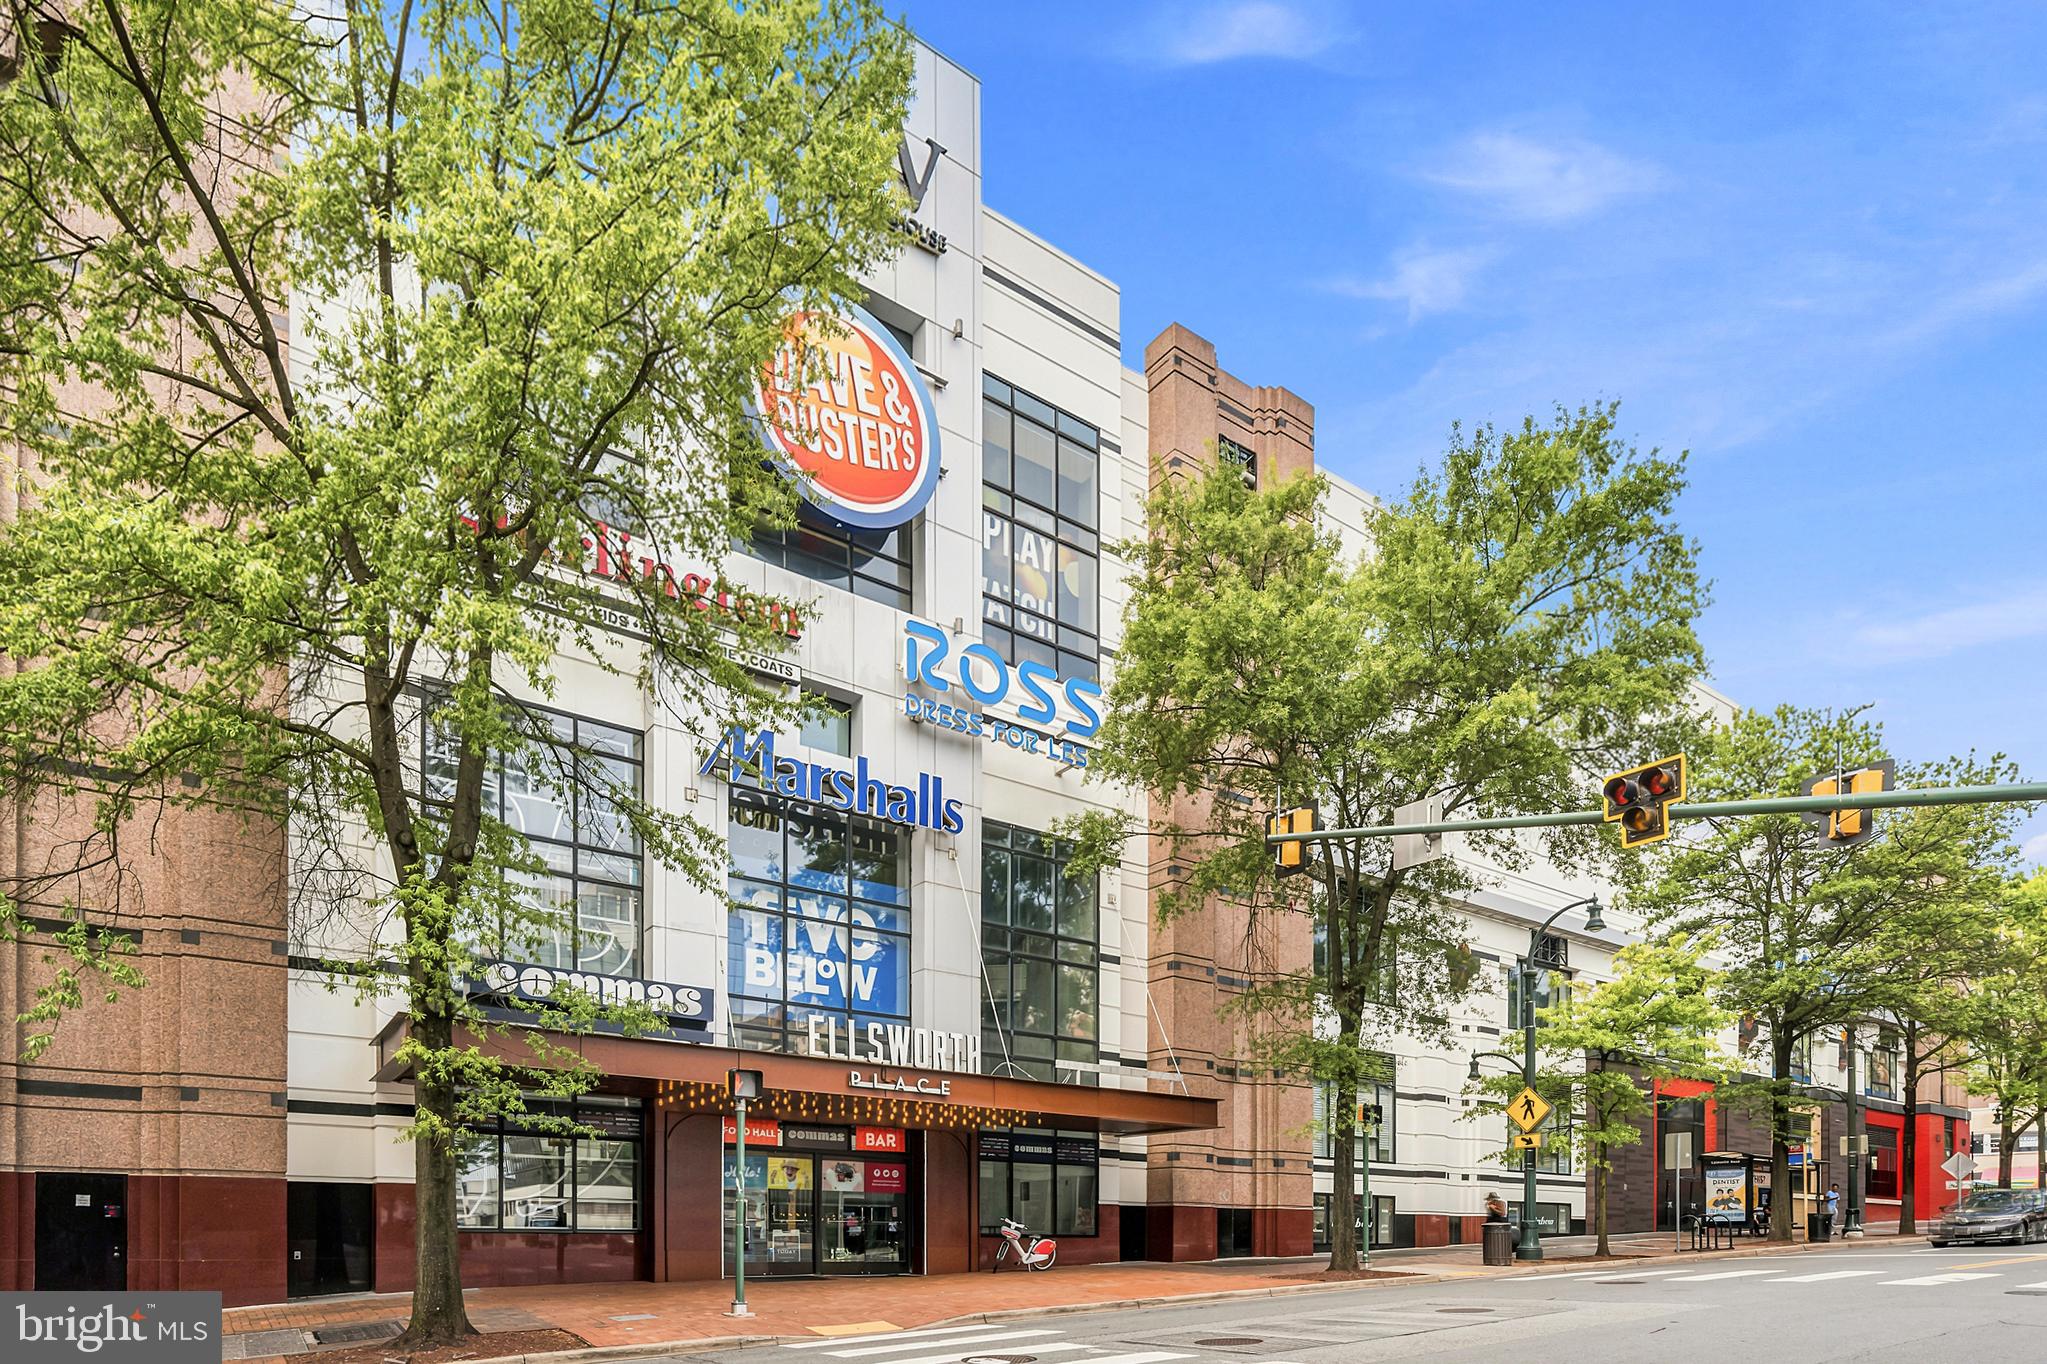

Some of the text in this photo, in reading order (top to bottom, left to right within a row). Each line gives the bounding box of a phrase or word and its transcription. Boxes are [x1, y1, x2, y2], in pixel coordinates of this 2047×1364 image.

[880, 370, 912, 427] &
[776, 394, 916, 472] BUSTER'S
[983, 512, 1055, 573] PLAY
[750, 654, 794, 677] COATS
[903, 619, 1103, 738] ROSS
[904, 693, 1090, 768] DRESS FOR LES
[698, 724, 964, 836] Marshalls
[750, 890, 878, 961] five
[485, 962, 703, 1017] commas
[745, 946, 878, 1001] BELOW
[808, 1014, 982, 1075] ELLSWORTH
[850, 1071, 951, 1096] PLACE
[724, 1125, 777, 1139] FOD HALL
[787, 1129, 846, 1143] commas
[865, 1132, 897, 1148] BAR
